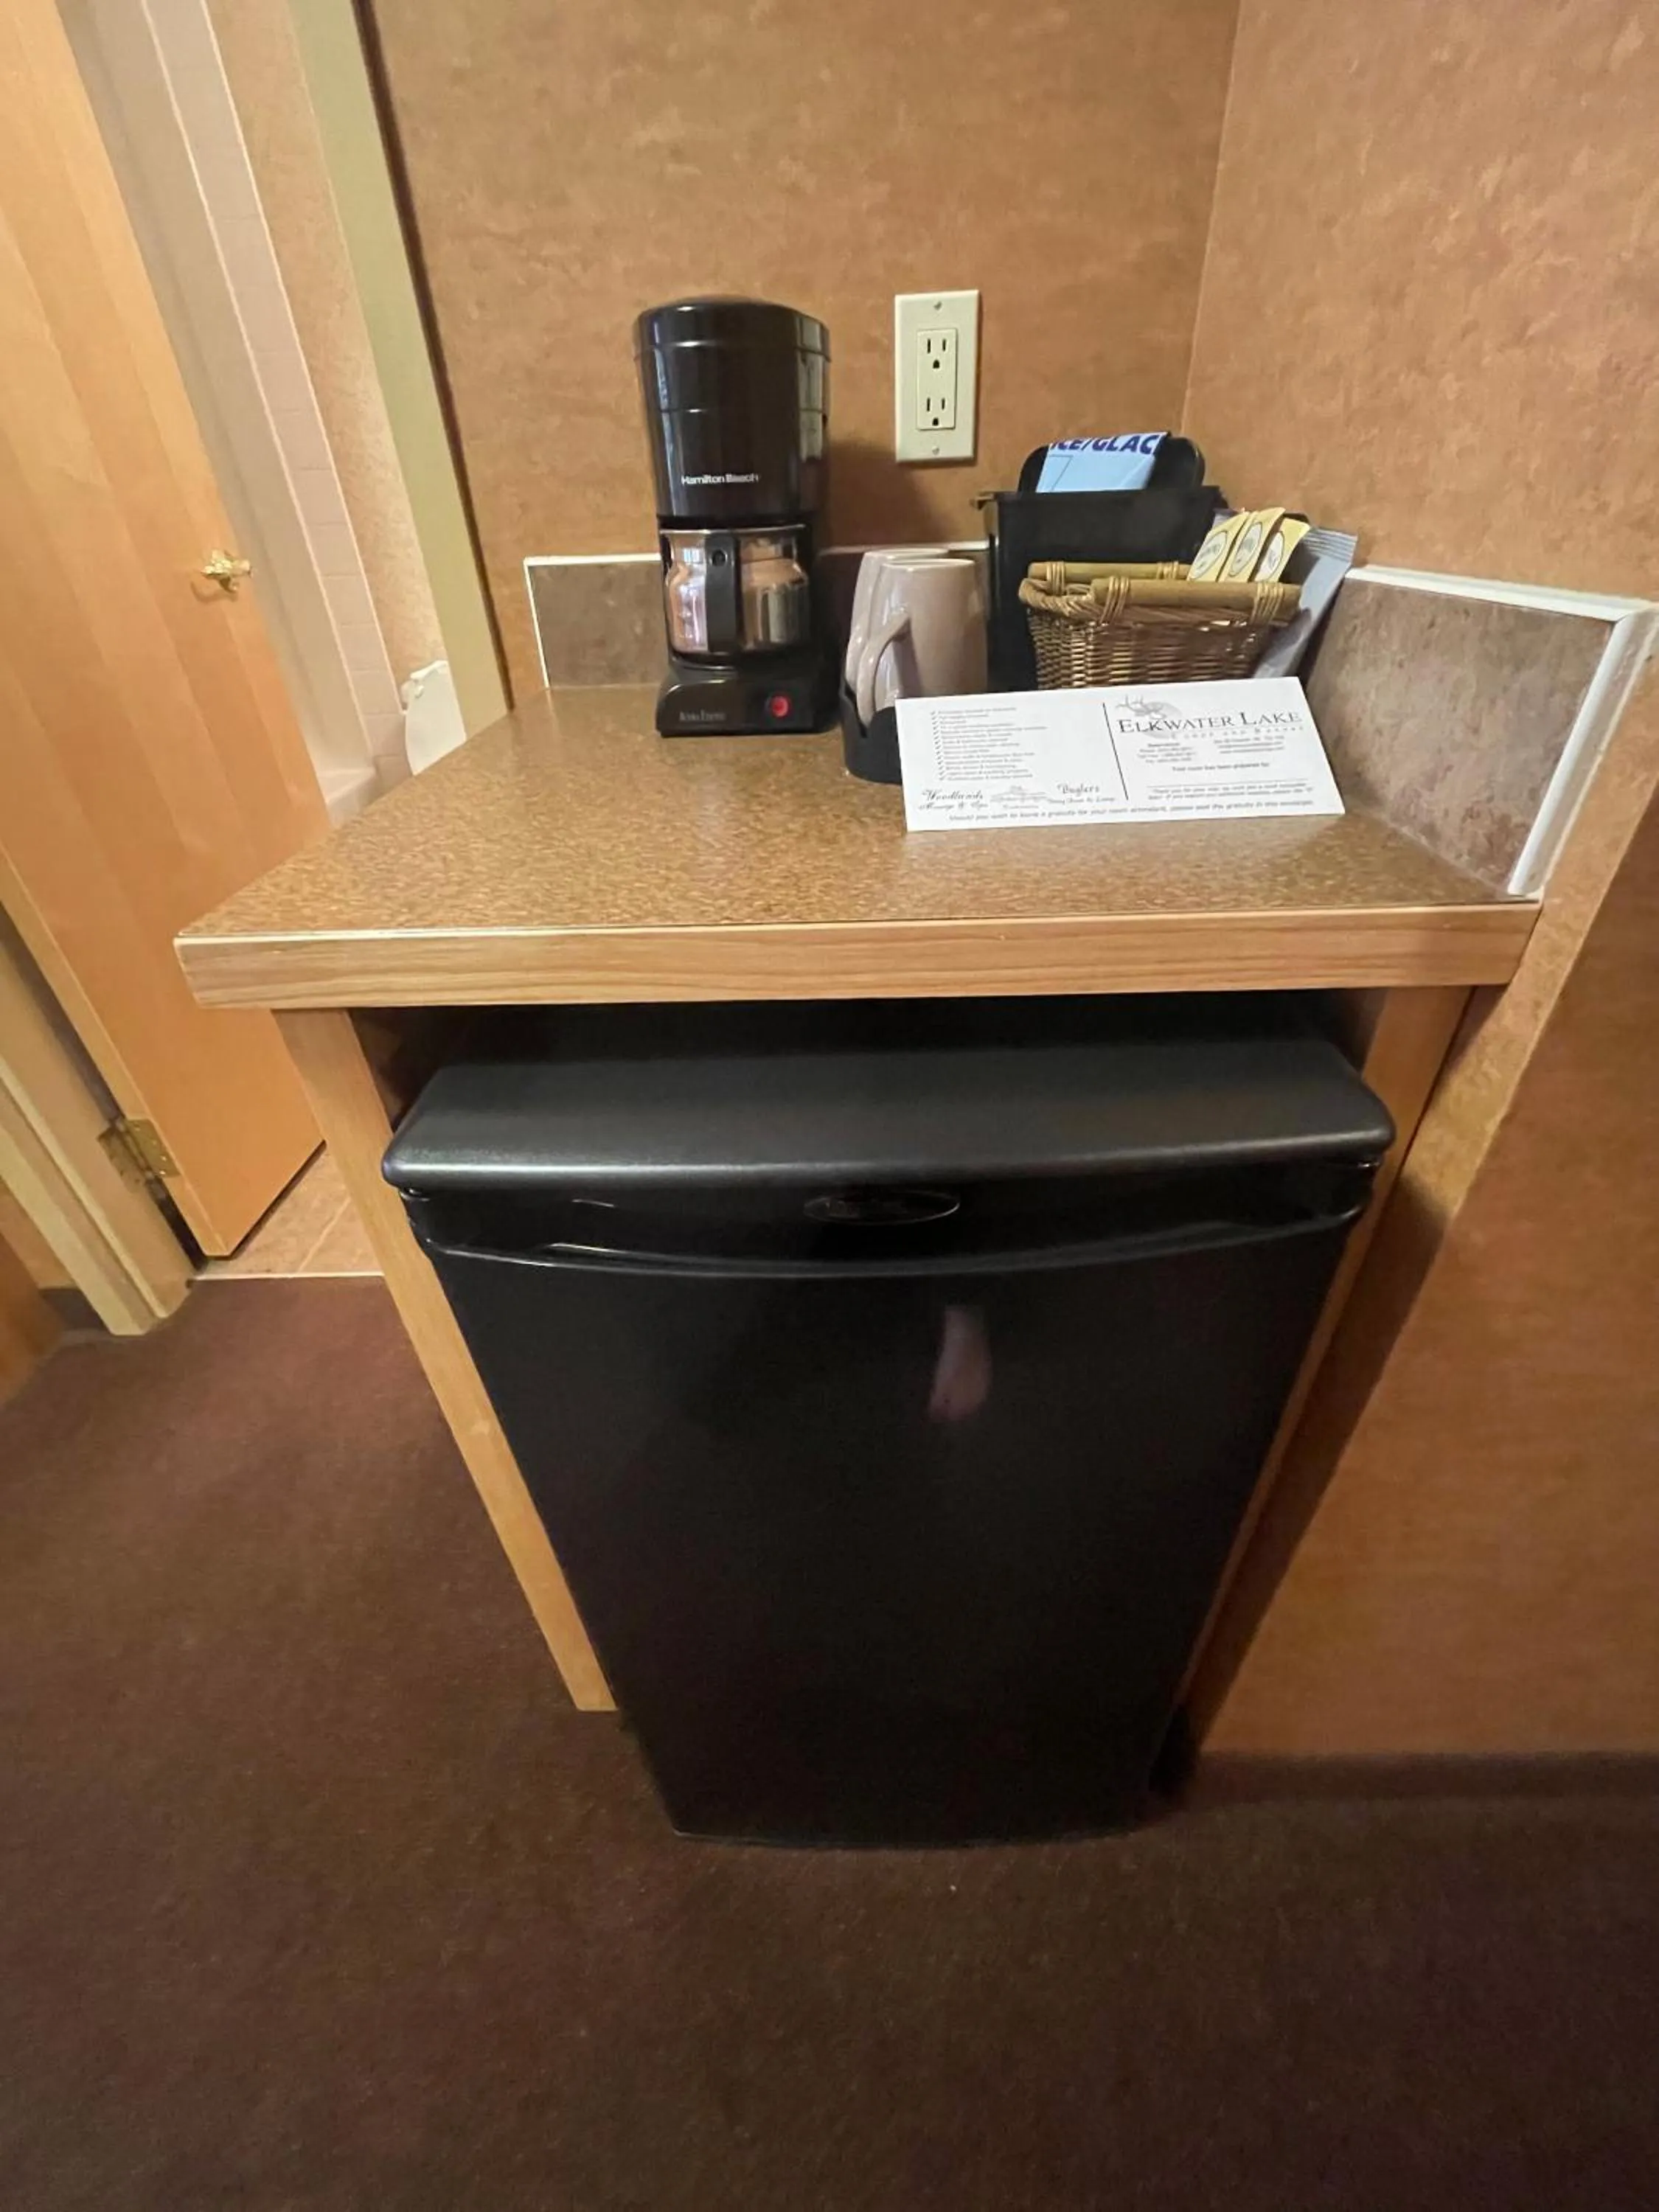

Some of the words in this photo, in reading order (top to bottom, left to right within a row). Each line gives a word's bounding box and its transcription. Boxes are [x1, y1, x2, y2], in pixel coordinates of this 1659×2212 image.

[681, 474, 725, 484] Hamilton
[726, 473, 759, 483] Beach
[1117, 716, 1234, 734] ELKWATER
[1237, 712, 1302, 726] LAKE
